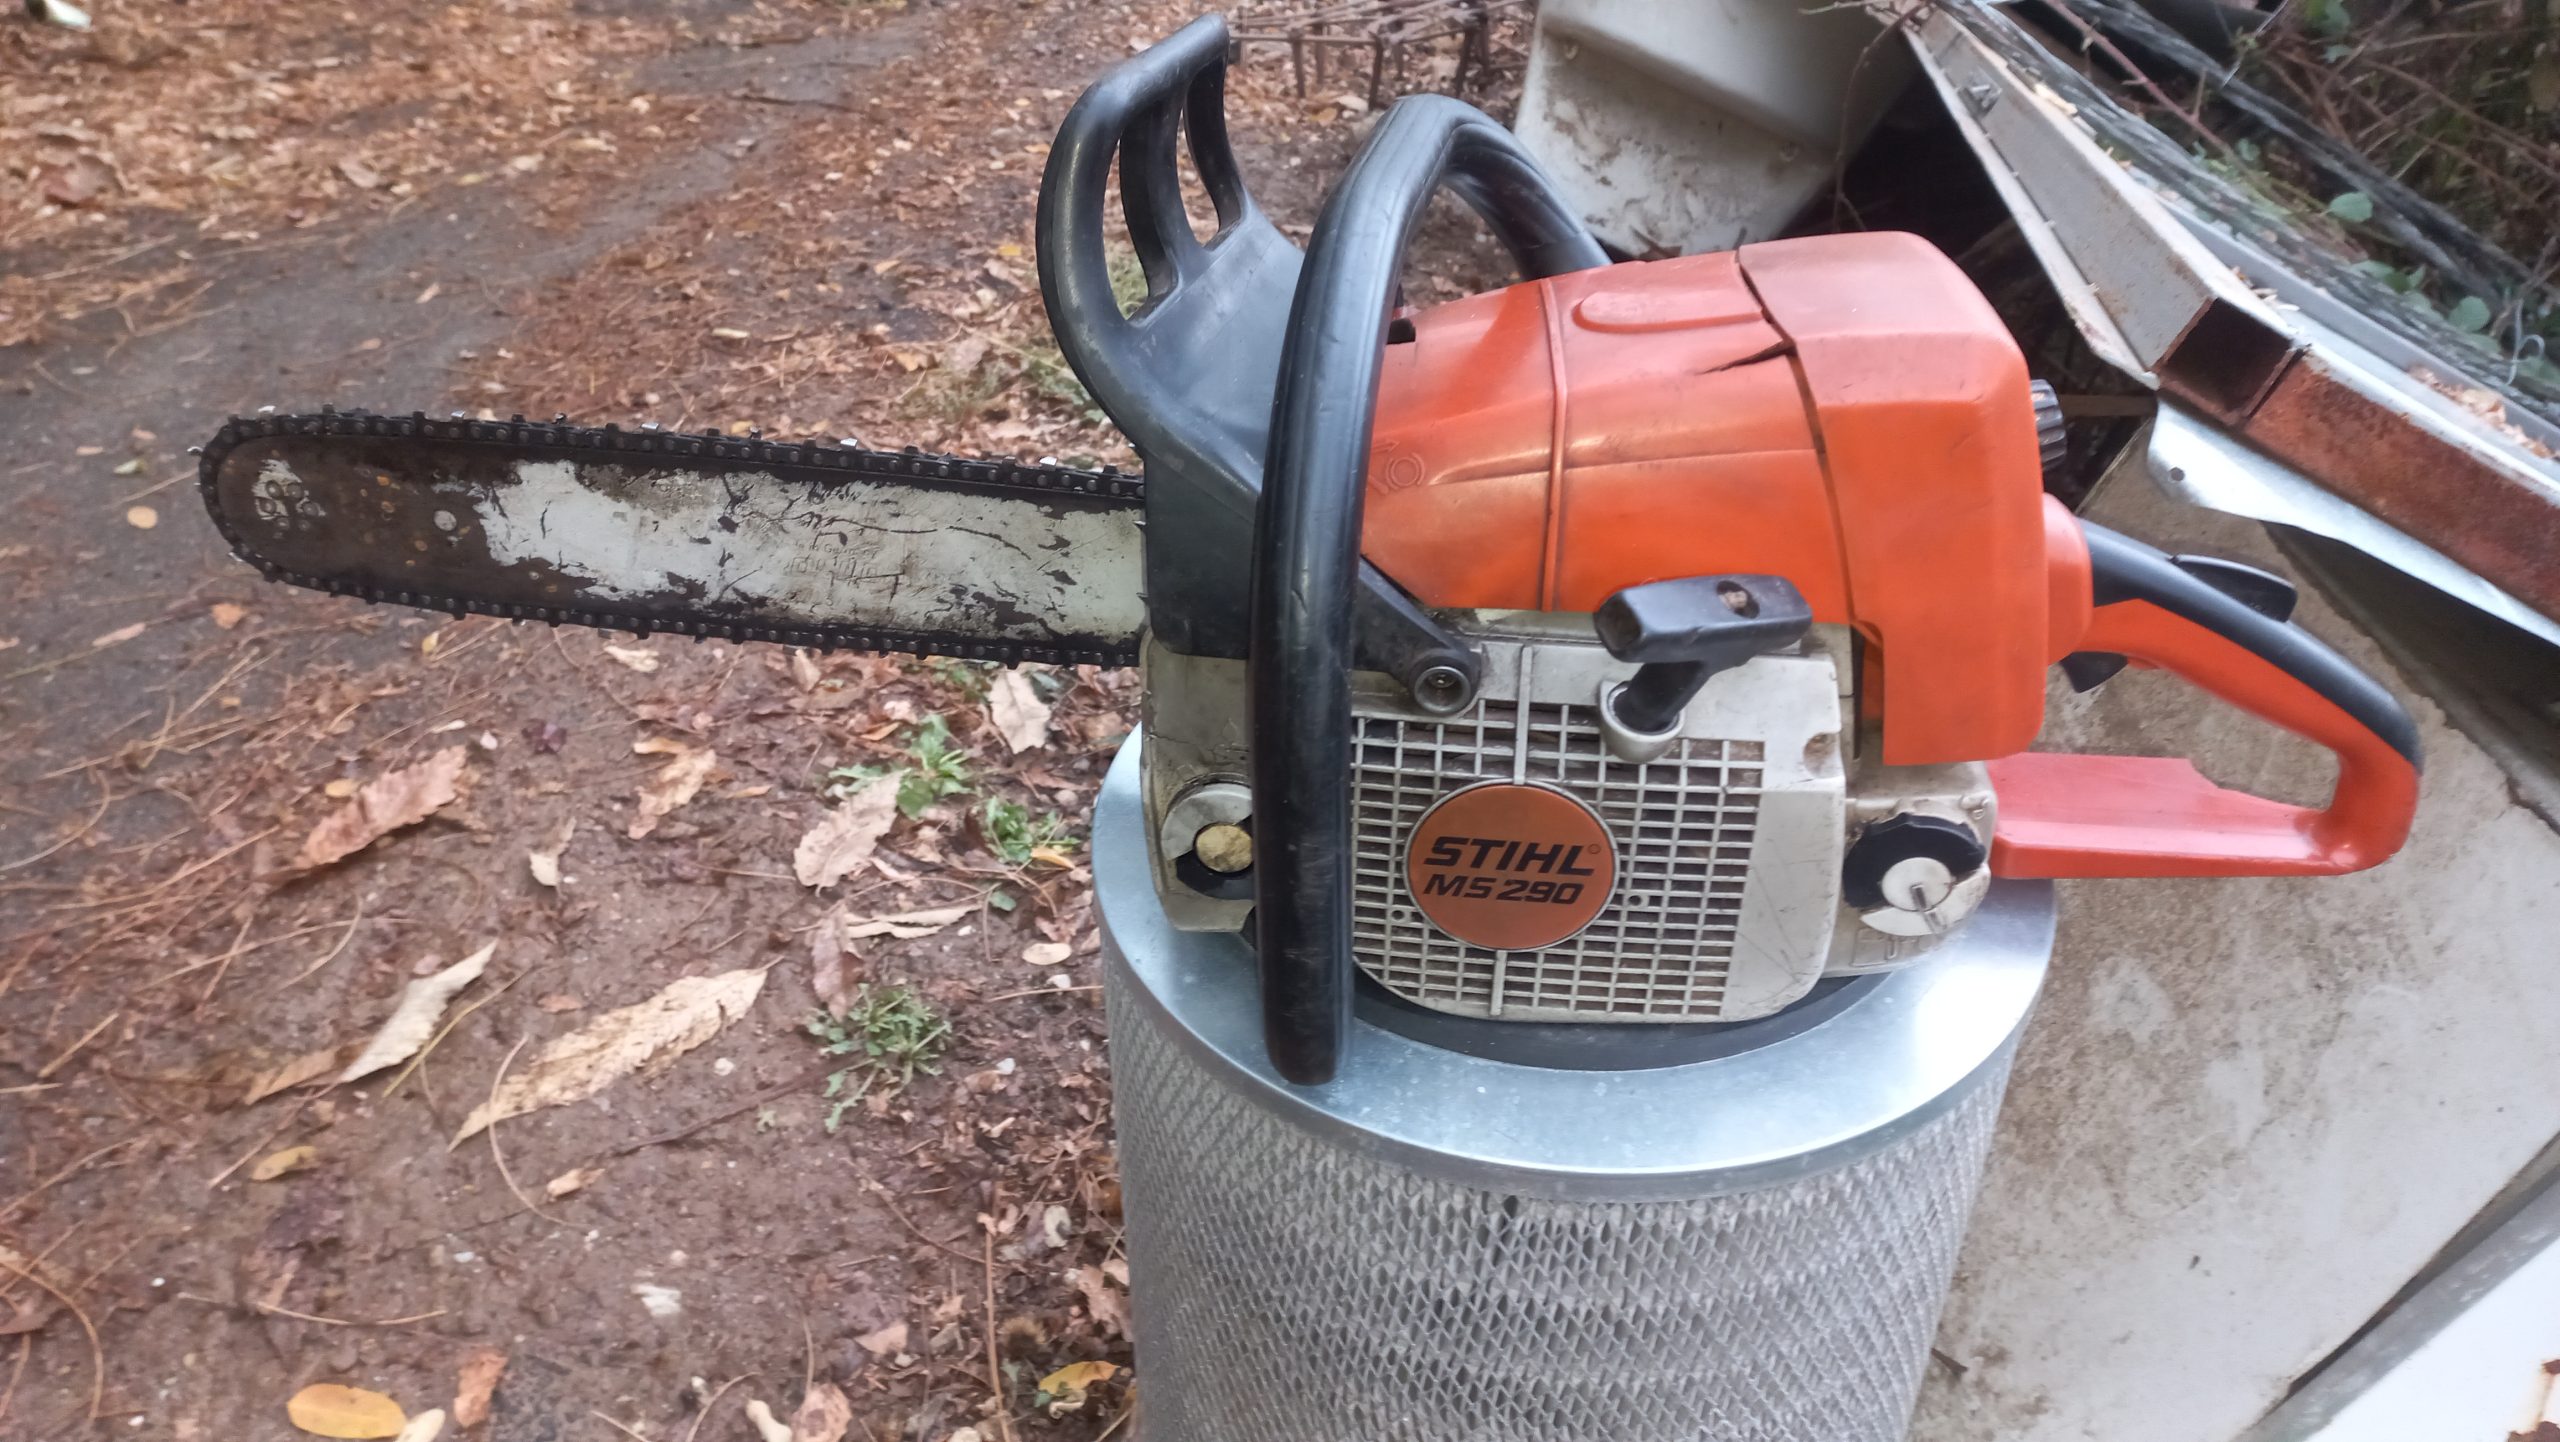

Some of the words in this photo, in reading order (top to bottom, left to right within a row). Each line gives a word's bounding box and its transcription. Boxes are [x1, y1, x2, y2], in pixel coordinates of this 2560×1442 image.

[1423, 836, 1595, 876] STIHL
[1423, 873, 1496, 899] MS
[1496, 879, 1584, 905] 290
